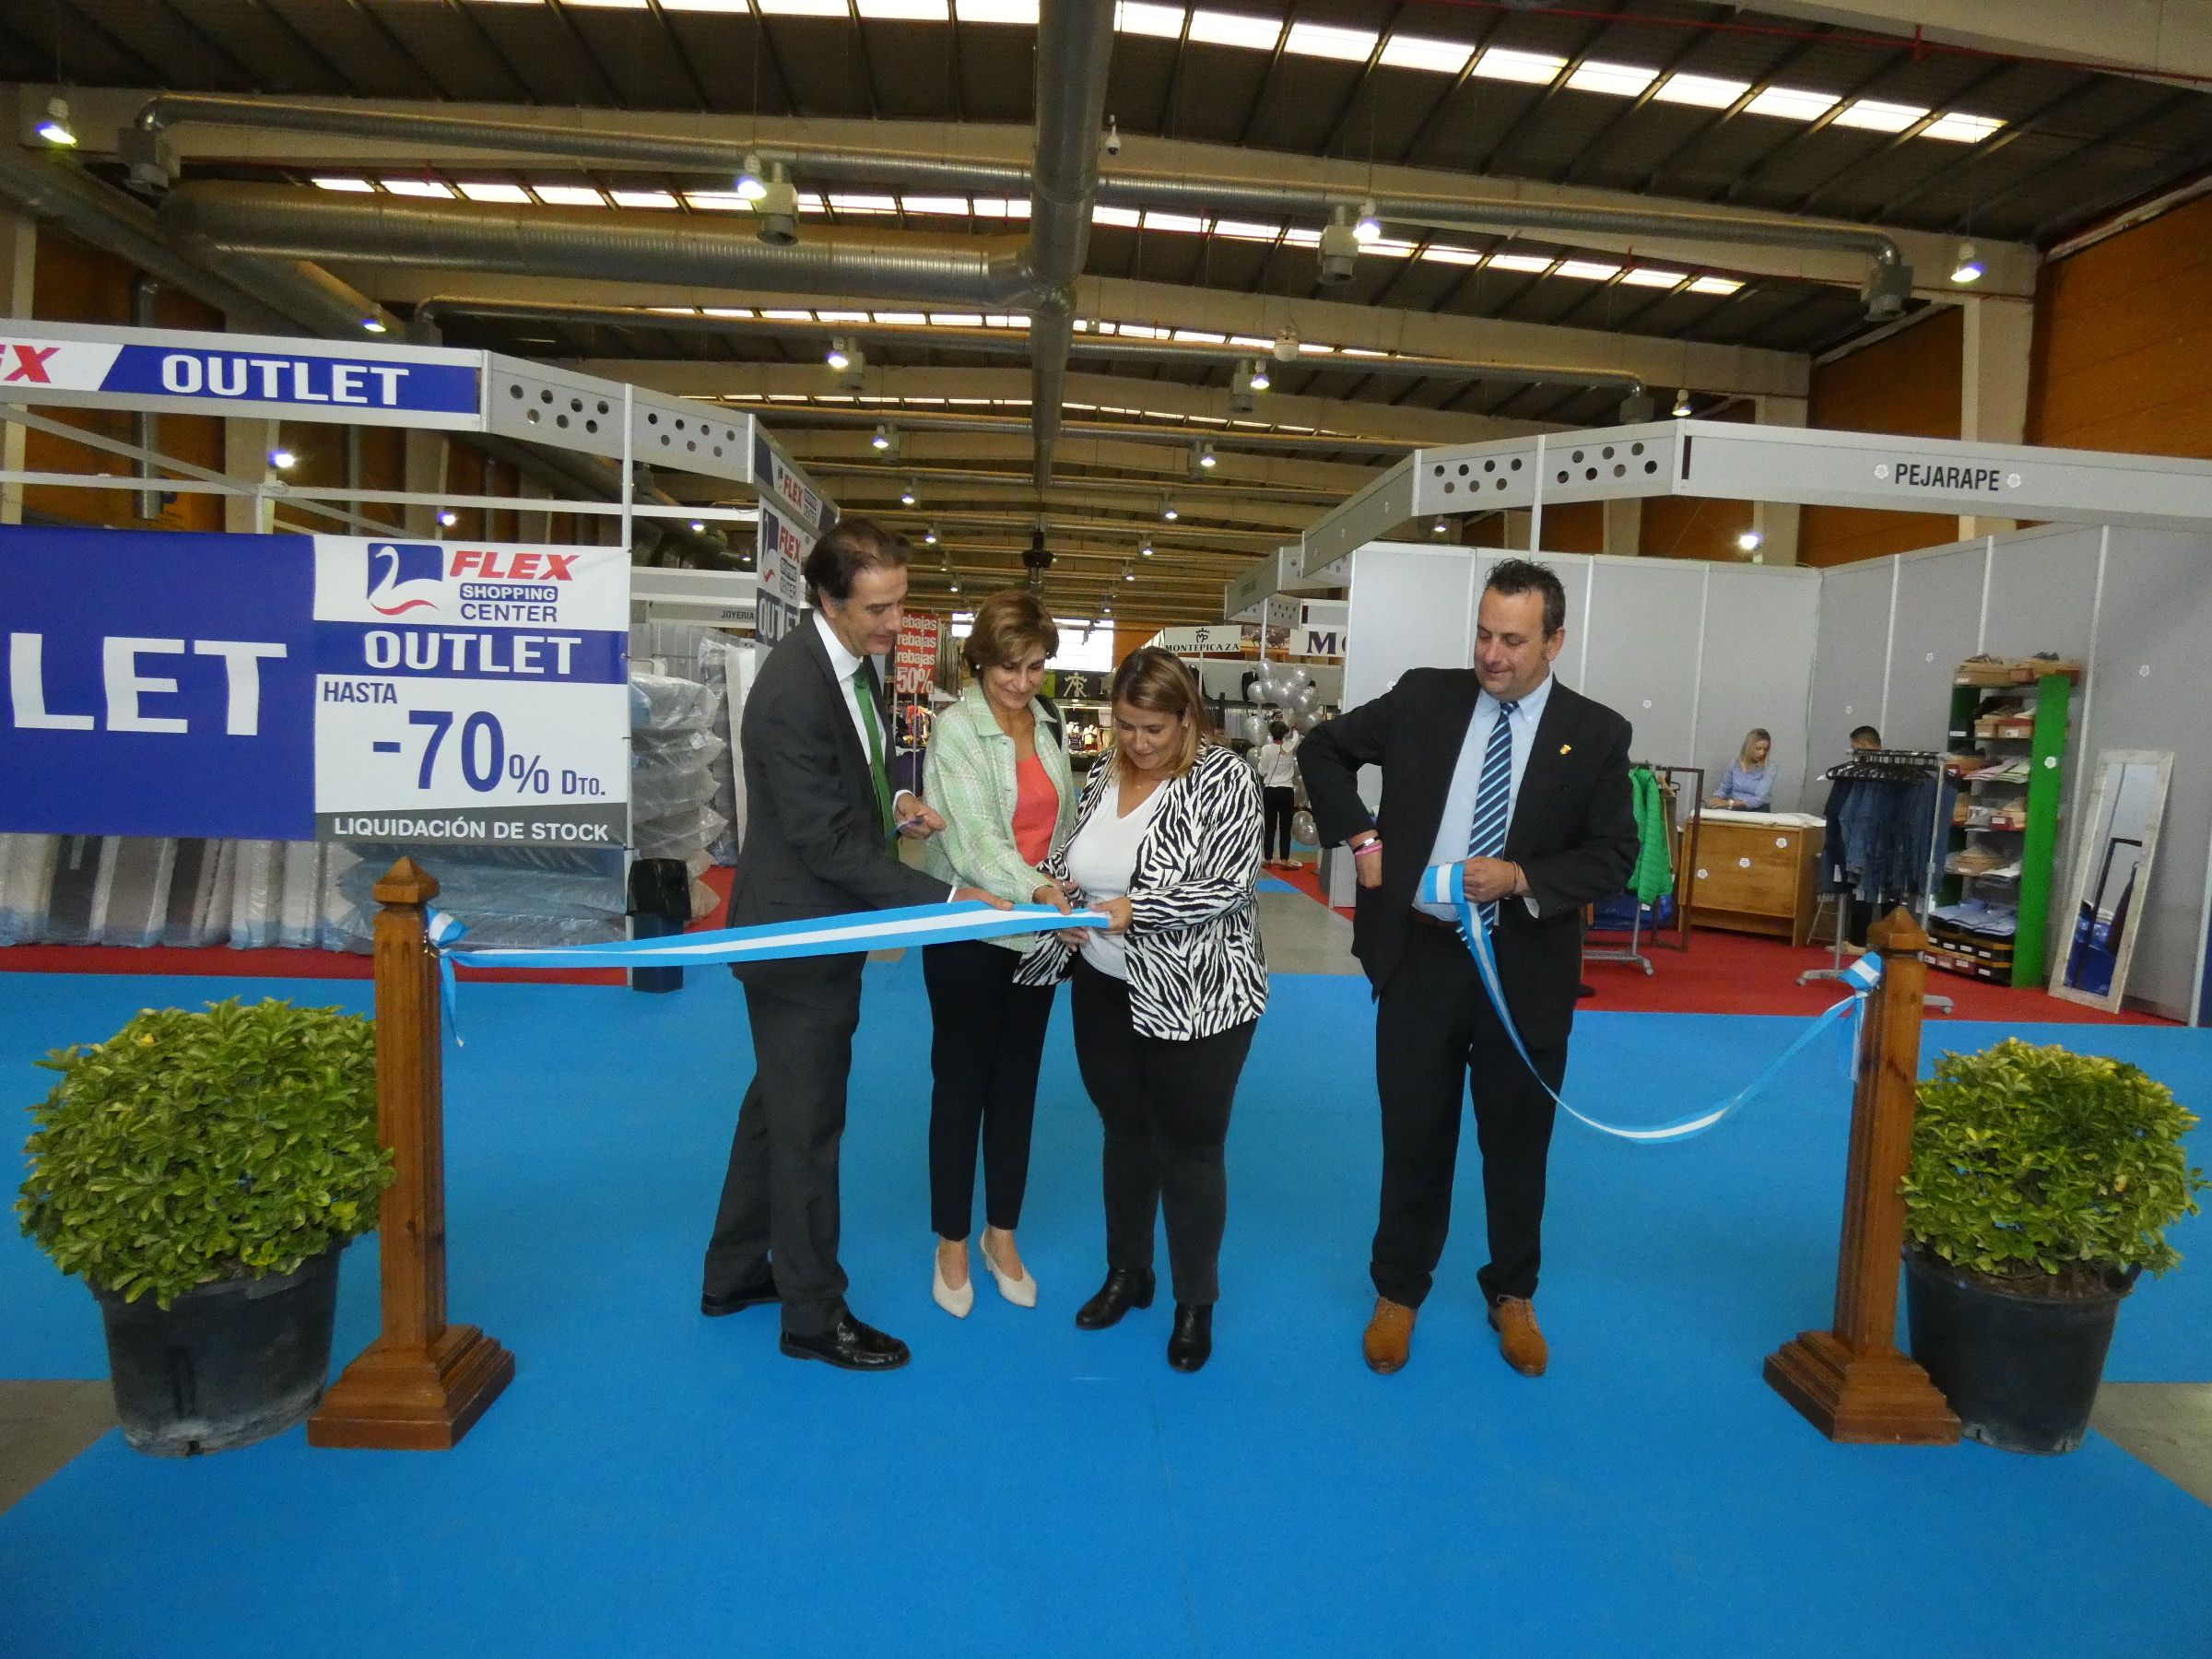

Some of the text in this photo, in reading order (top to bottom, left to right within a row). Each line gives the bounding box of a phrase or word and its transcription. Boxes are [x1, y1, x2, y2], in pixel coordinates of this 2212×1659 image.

[0, 344, 409, 406] X OUTLET
[1895, 463, 2000, 491] PEJARAPE
[780, 525, 802, 564] FLEX
[450, 550, 581, 582] FLEX
[462, 584, 556, 601] SHOPPING
[461, 603, 558, 623] CENTER
[721, 610, 755, 620] JOYERIA
[364, 629, 582, 676] OUTLET
[897, 631, 936, 651] rebajas
[896, 649, 935, 668] rebajas
[9, 632, 288, 736] LET
[323, 681, 398, 704] HASTA
[896, 666, 935, 693] 50%
[372, 710, 550, 794] -70%
[335, 816, 609, 841] LIQUIDACIÓN DE STOCK
